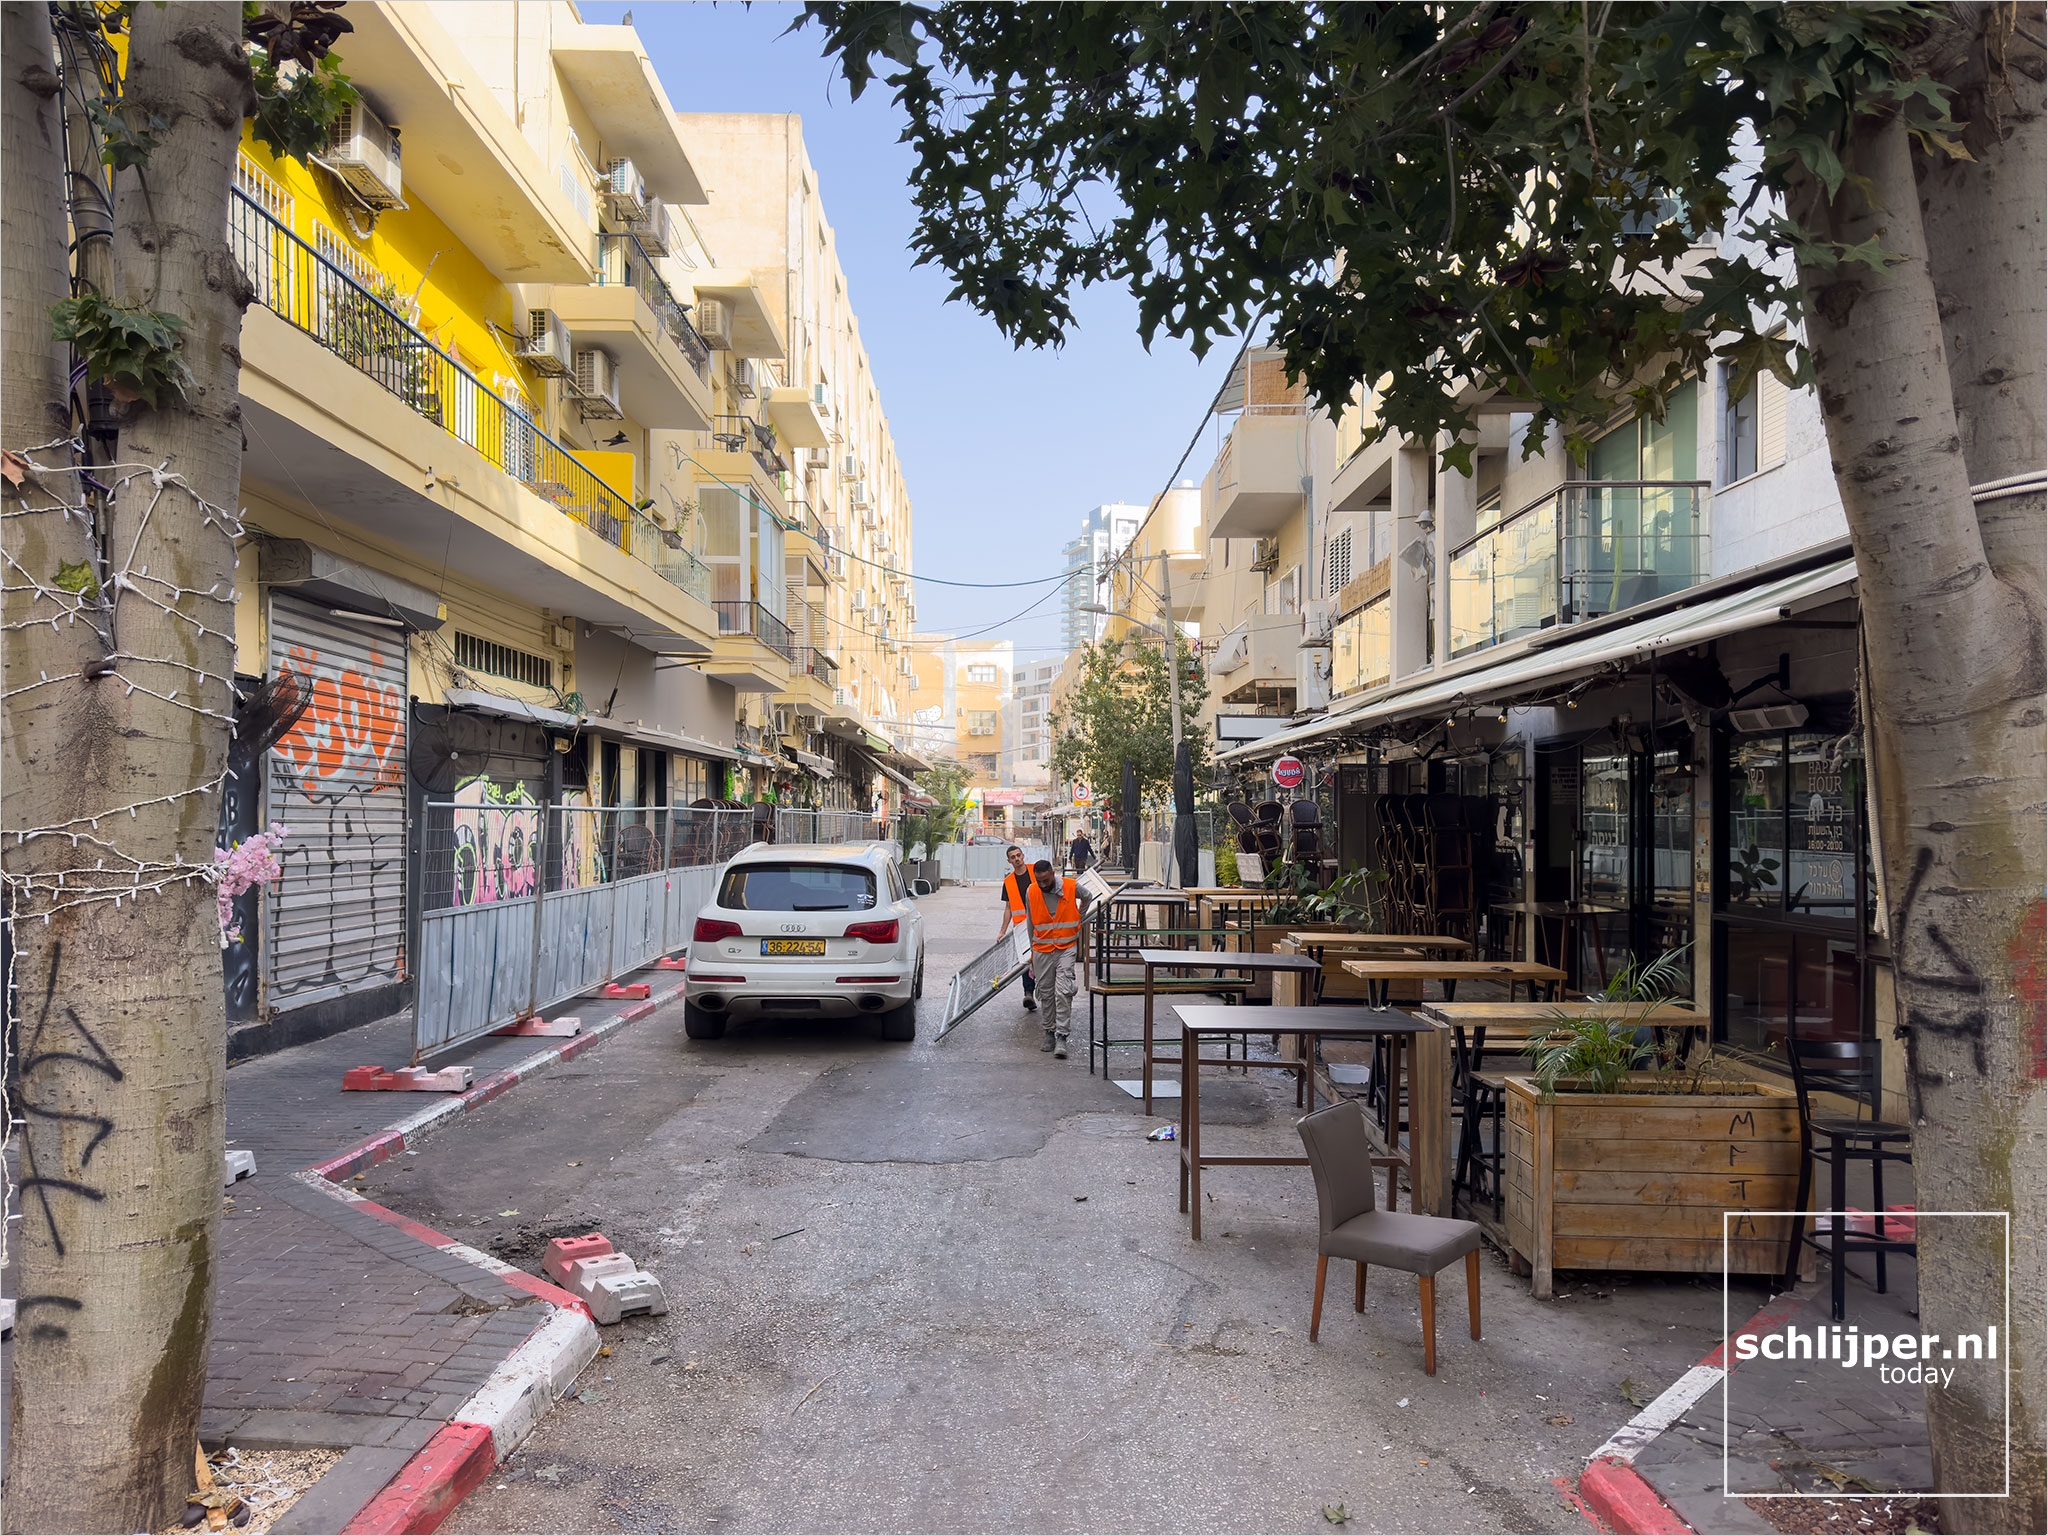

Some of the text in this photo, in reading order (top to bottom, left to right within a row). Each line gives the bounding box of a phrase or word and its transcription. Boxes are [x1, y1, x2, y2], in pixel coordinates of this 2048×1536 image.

[1808, 777, 1842, 793] HOUR
[1827, 802, 1842, 822] כל
[1592, 831, 1617, 847] כניסה
[1808, 840, 1843, 850] 16:00-20:00
